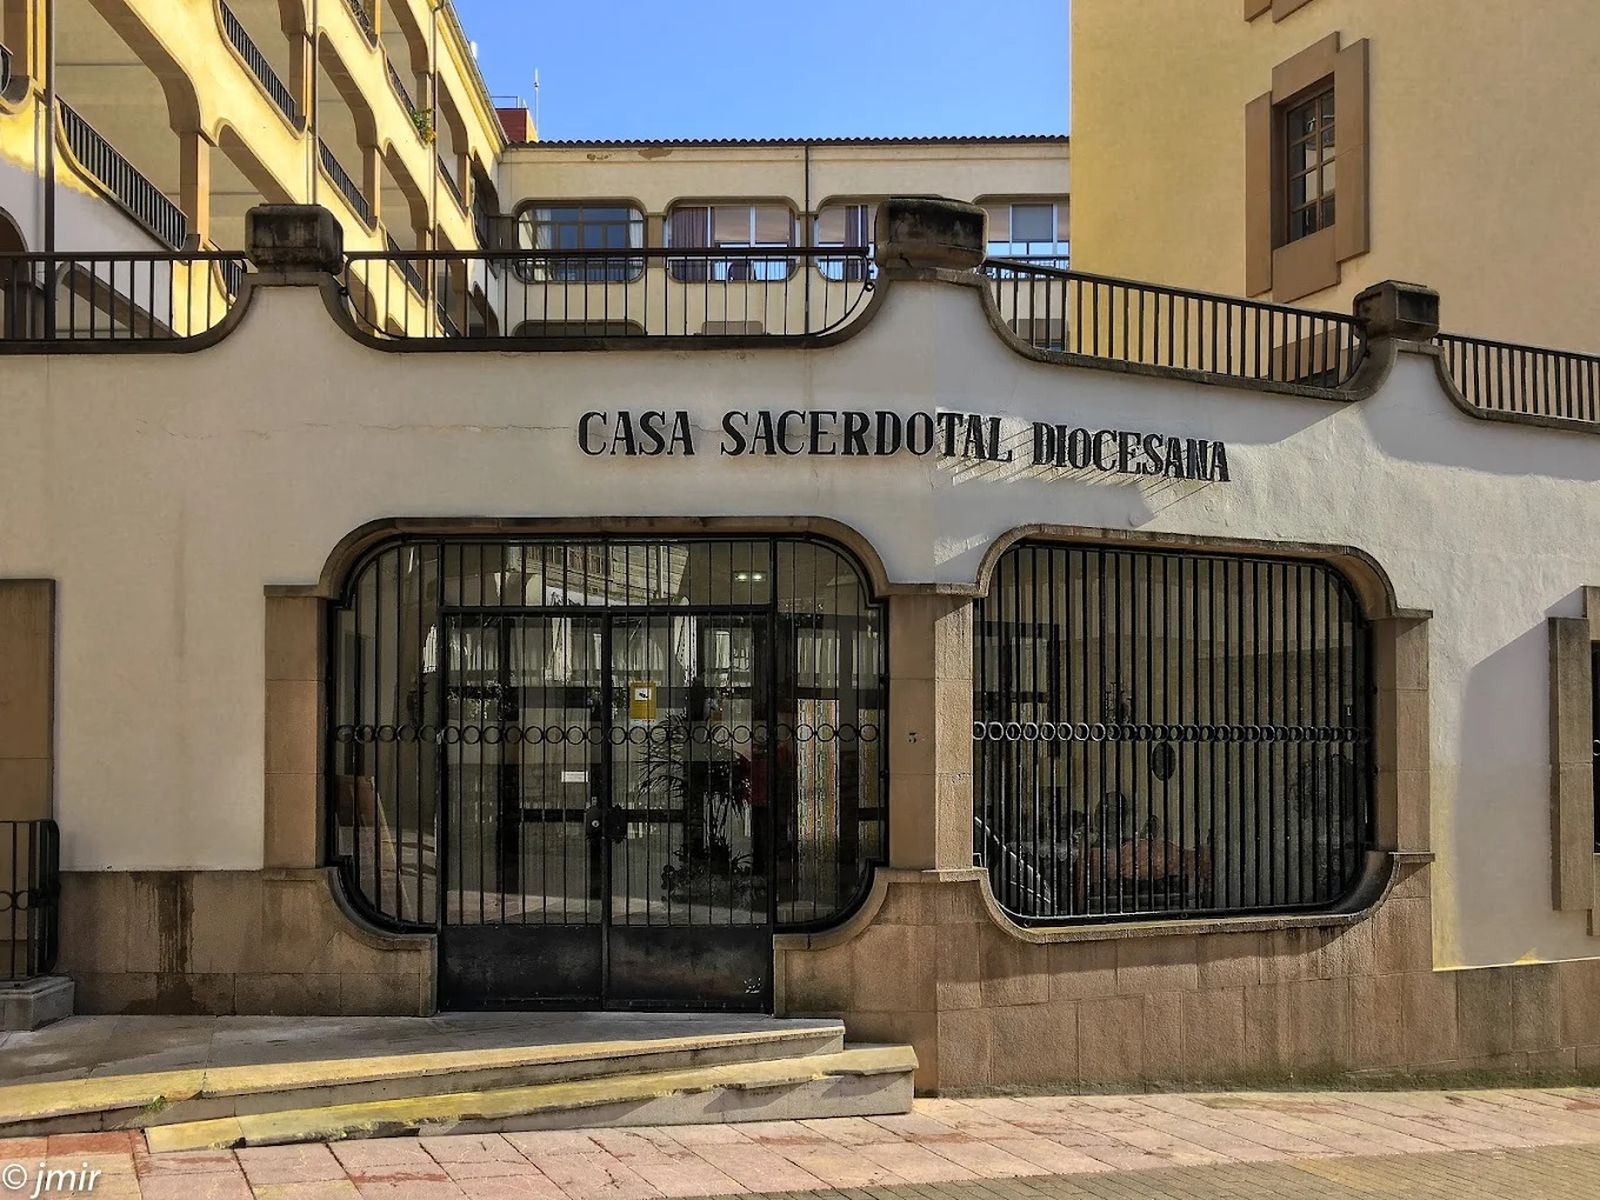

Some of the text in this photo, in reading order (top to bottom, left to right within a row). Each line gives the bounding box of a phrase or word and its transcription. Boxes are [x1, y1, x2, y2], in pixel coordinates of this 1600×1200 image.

[578, 410, 1230, 482] CASA SACERDOTAL DIOCESANA
